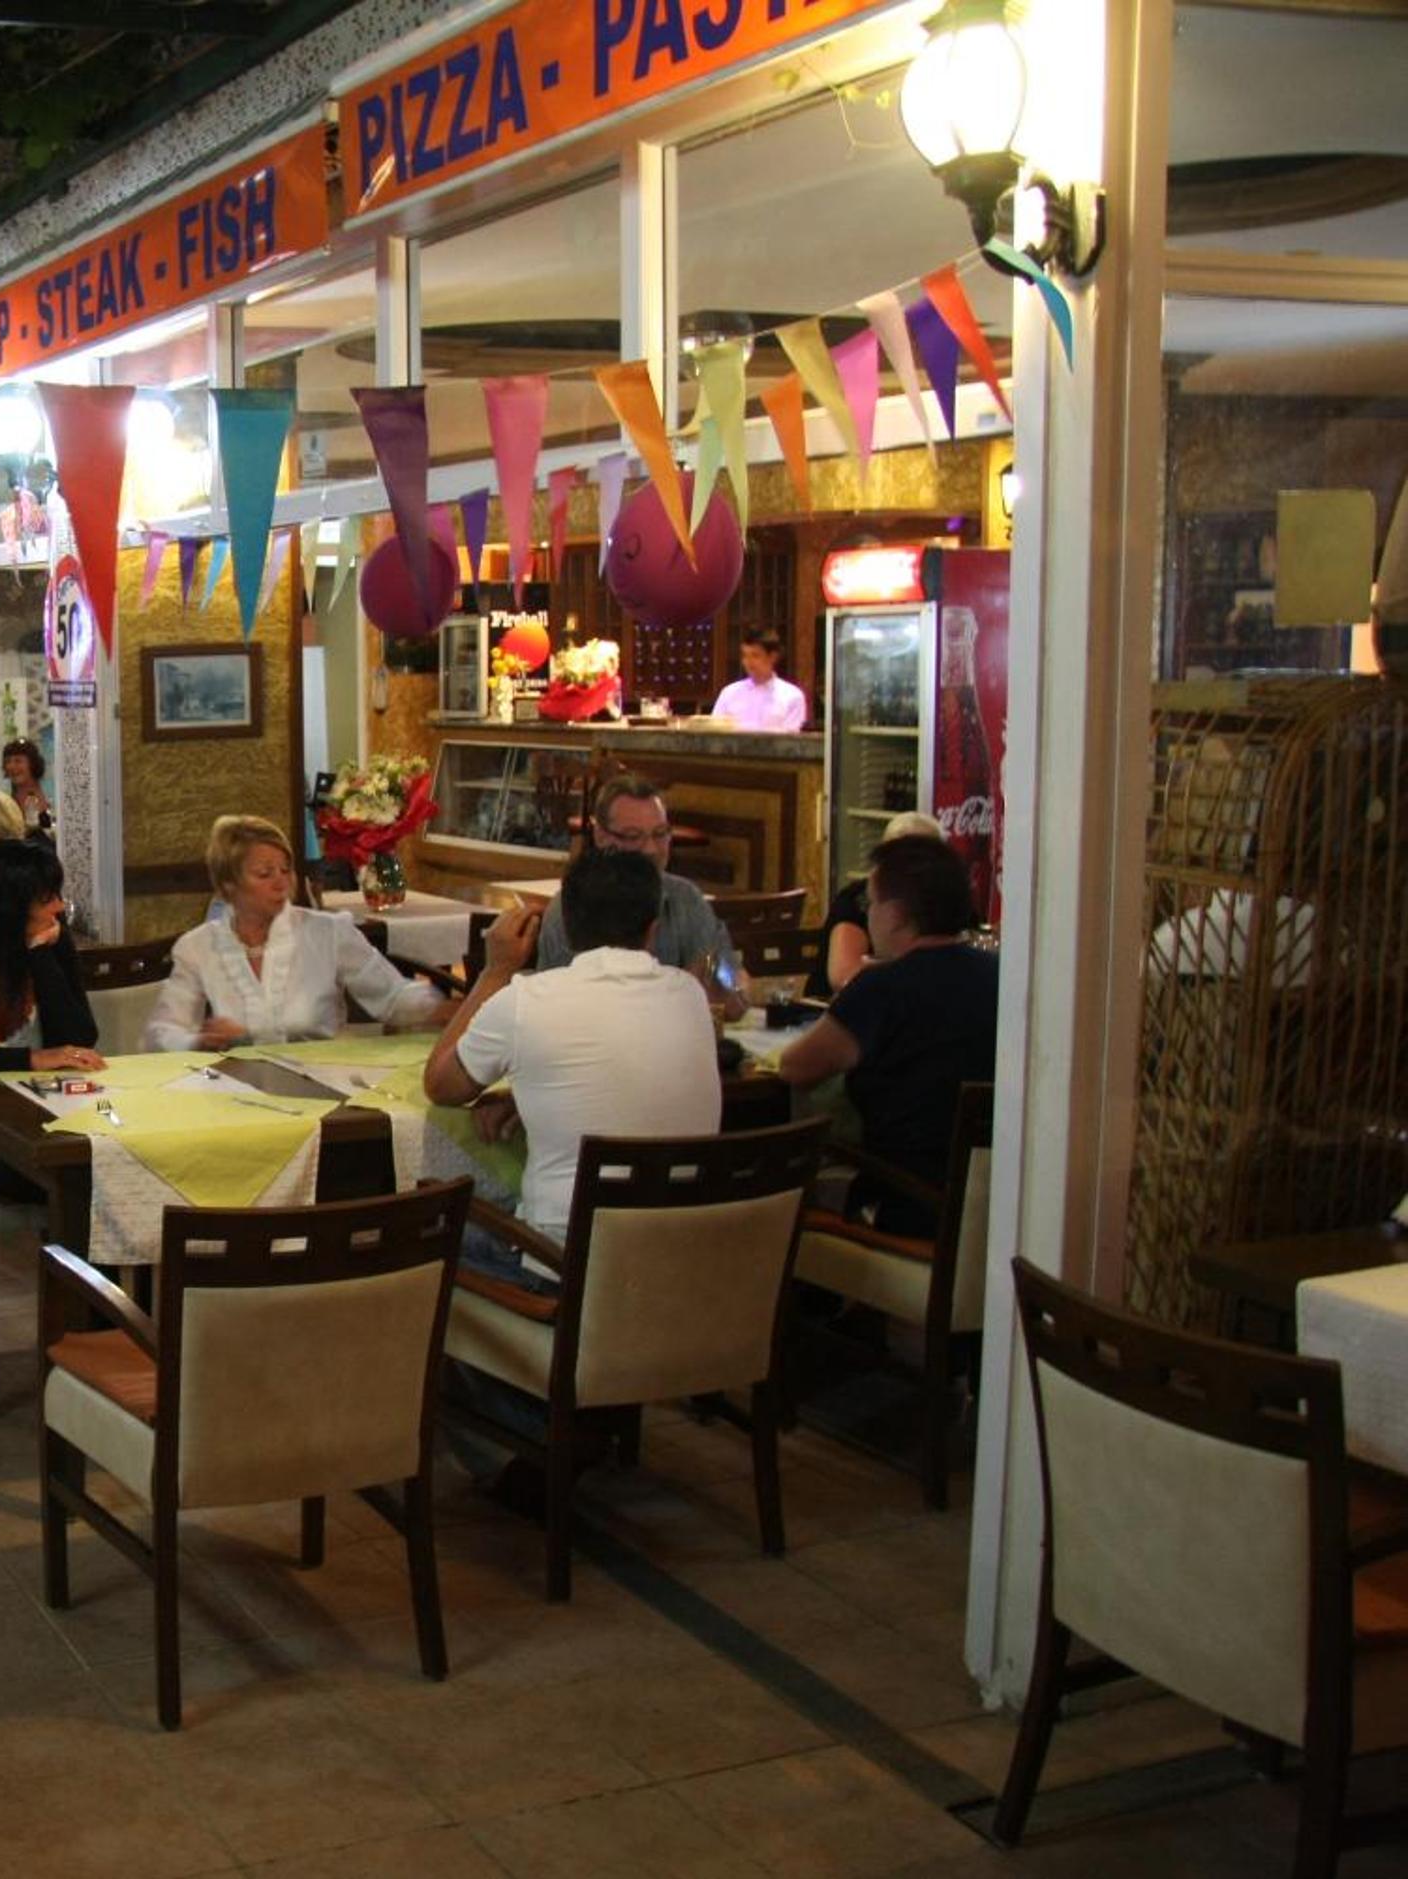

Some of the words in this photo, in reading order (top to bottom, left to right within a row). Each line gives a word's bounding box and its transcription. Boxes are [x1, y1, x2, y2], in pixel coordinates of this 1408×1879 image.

[358, 27, 528, 195] PIZZA
[37, 233, 145, 348] STEAK
[177, 167, 277, 289] FISH
